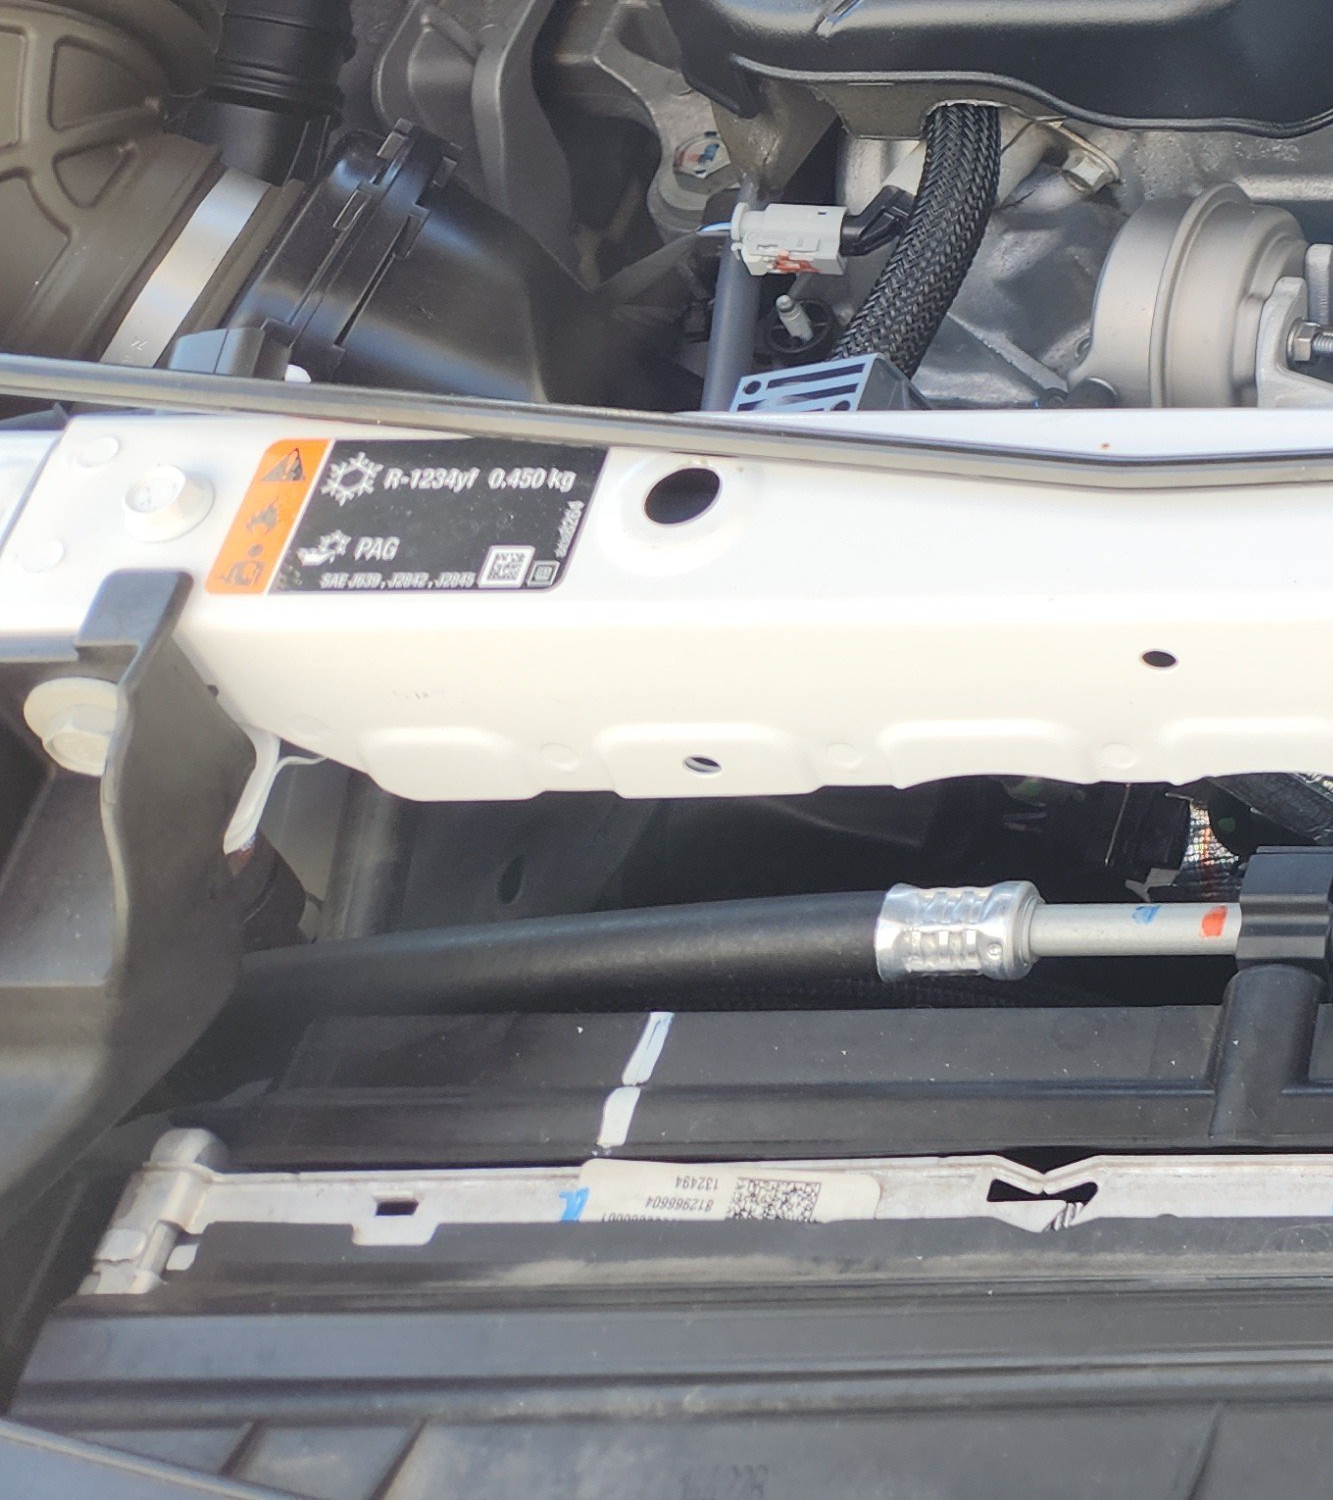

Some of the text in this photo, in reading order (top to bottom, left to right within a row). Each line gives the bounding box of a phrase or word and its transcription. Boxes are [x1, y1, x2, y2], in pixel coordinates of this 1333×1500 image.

[383, 467, 576, 492] R-1234yf 0.450 kg
[354, 536, 400, 562] PAG
[675, 1175, 719, 1191] 132494
